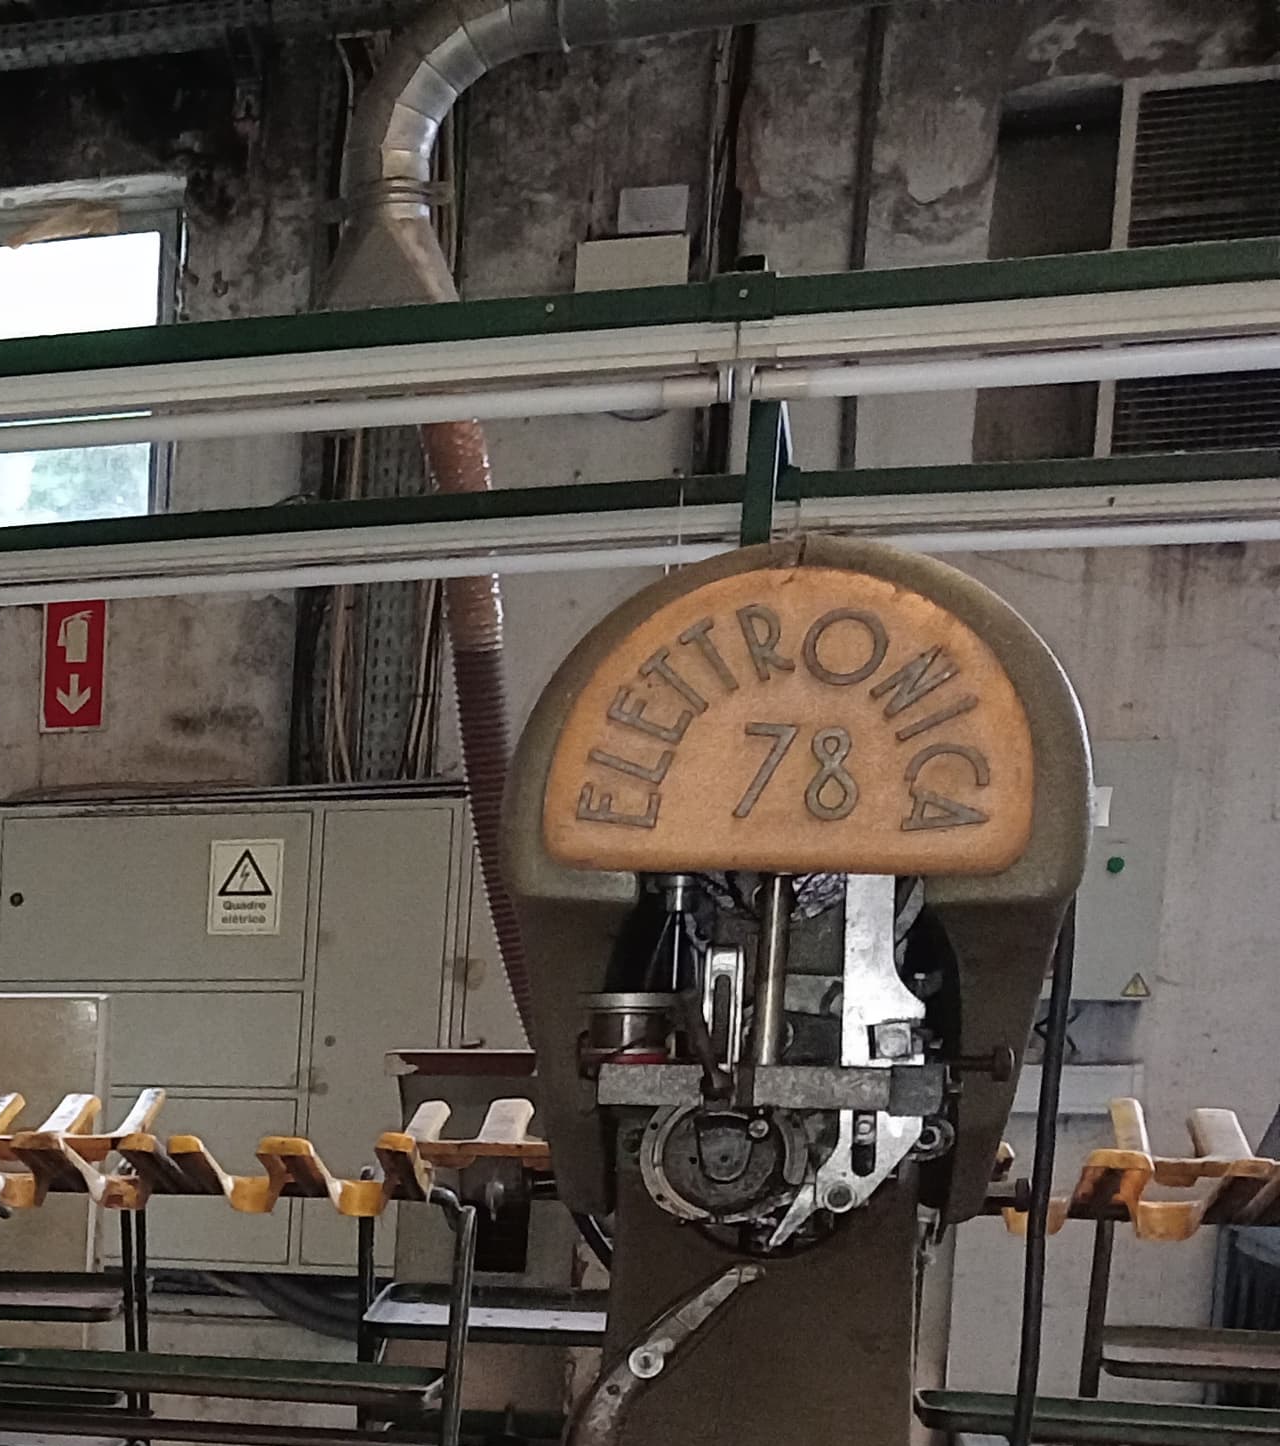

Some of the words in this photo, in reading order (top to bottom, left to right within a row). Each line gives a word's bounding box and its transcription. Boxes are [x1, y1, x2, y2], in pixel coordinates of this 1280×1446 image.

[575, 603, 991, 832] ELETTRONICA
[732, 722, 859, 821] 78
[222, 900, 267, 911] Quadro
